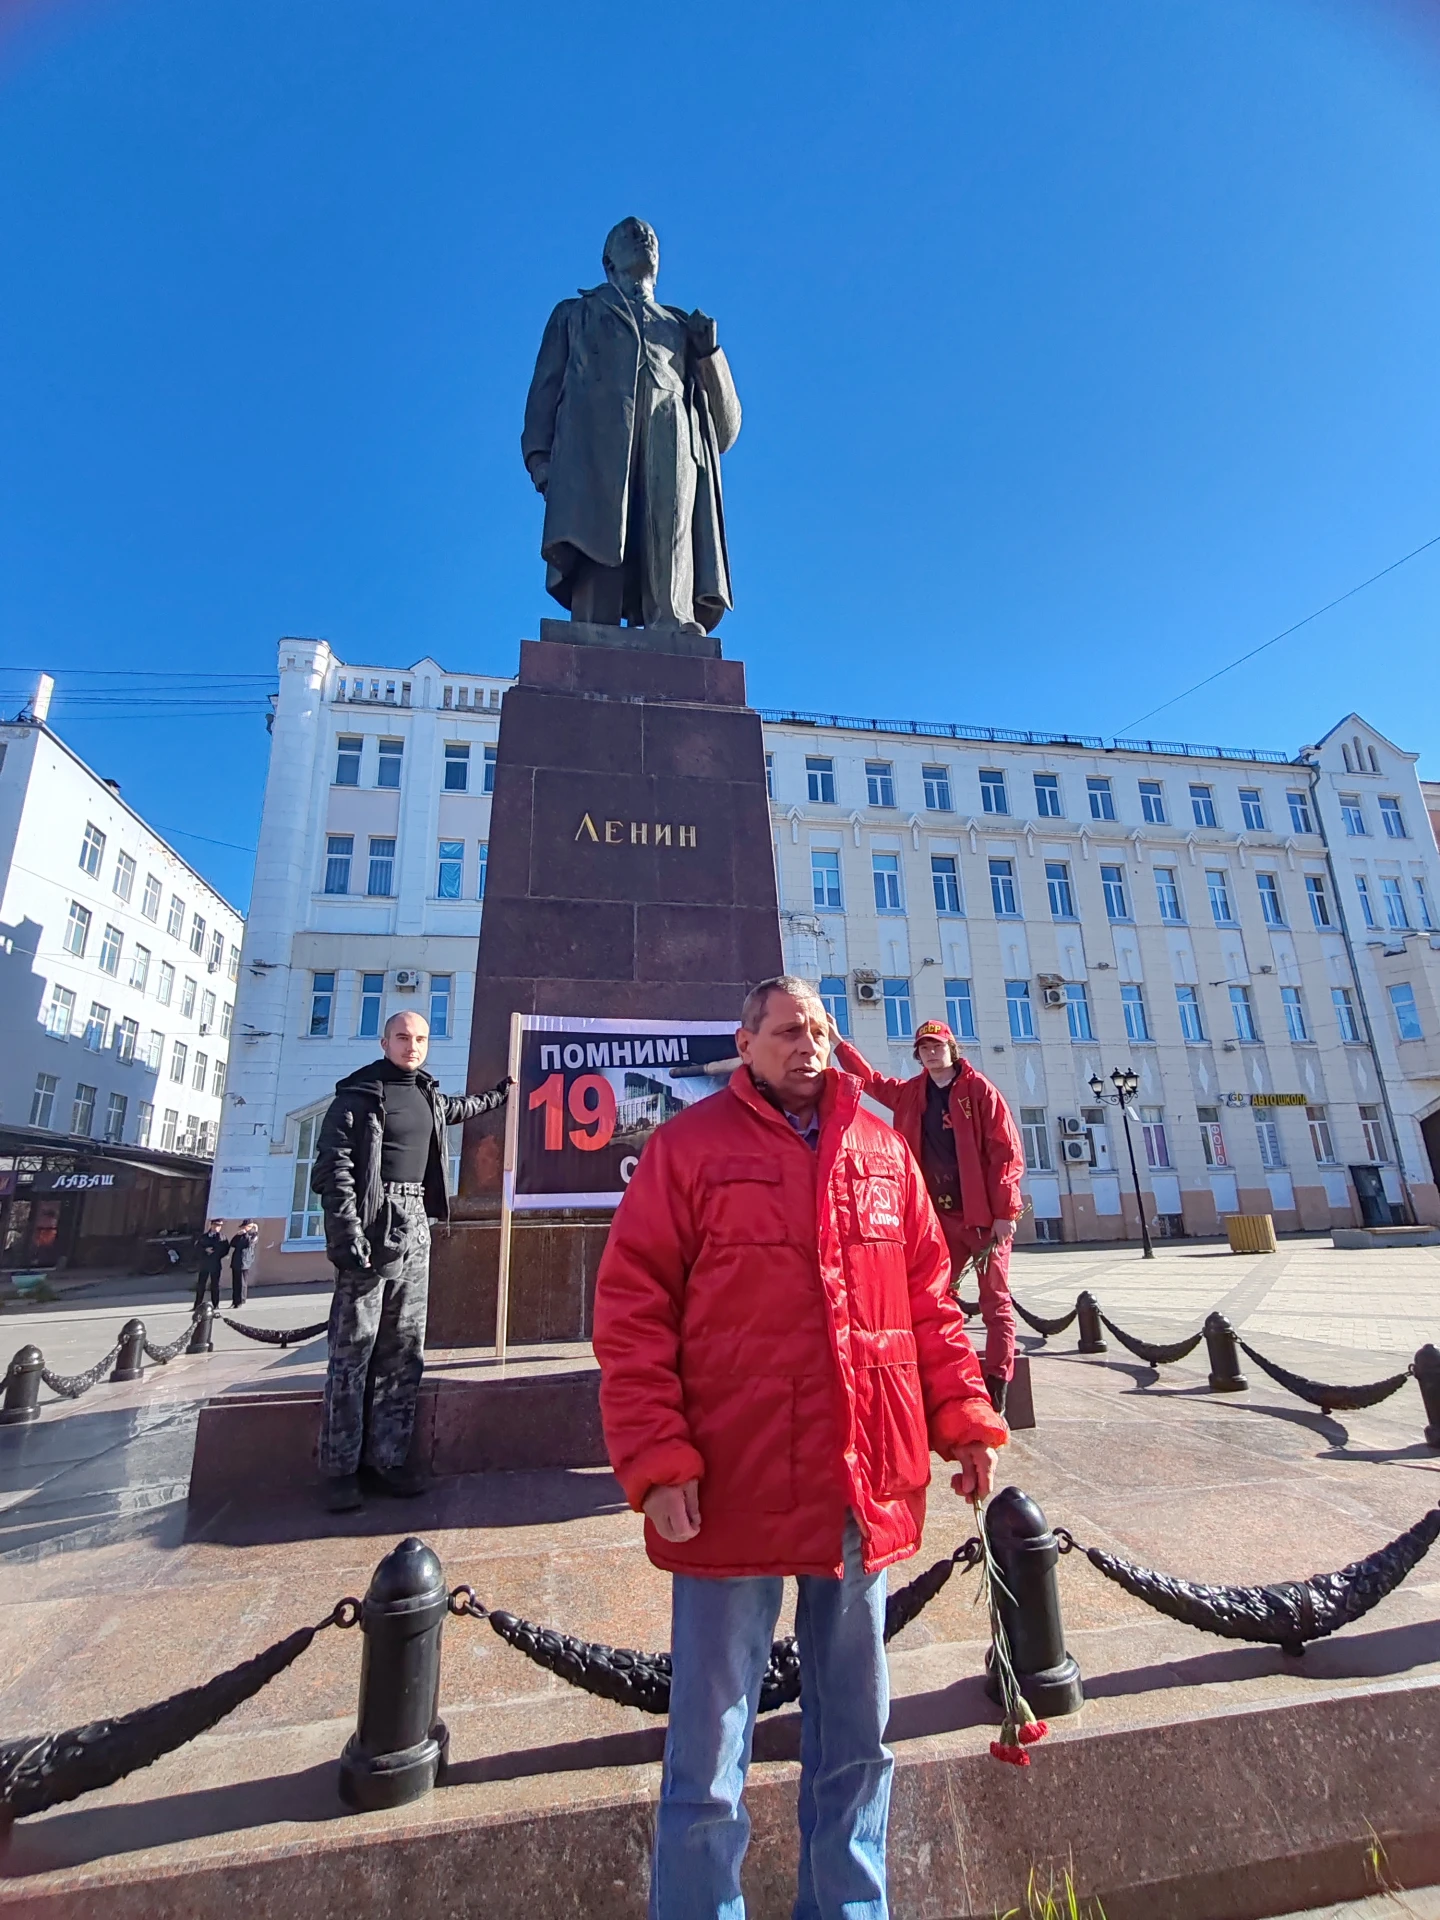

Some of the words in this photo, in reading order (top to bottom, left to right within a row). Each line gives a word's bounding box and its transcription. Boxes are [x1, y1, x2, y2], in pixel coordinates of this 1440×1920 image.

[918, 1023, 942, 1036] СССР
[540, 1037, 690, 1070] ПОМНИМ!
[1252, 1094, 1308, 1106] АВТОШКОЛА
[529, 1073, 617, 1151] 19
[1211, 1125, 1225, 1165] ФОТО
[51, 1174, 115, 1189] ЛАВАШ
[869, 1212, 900, 1228] КПРФ
